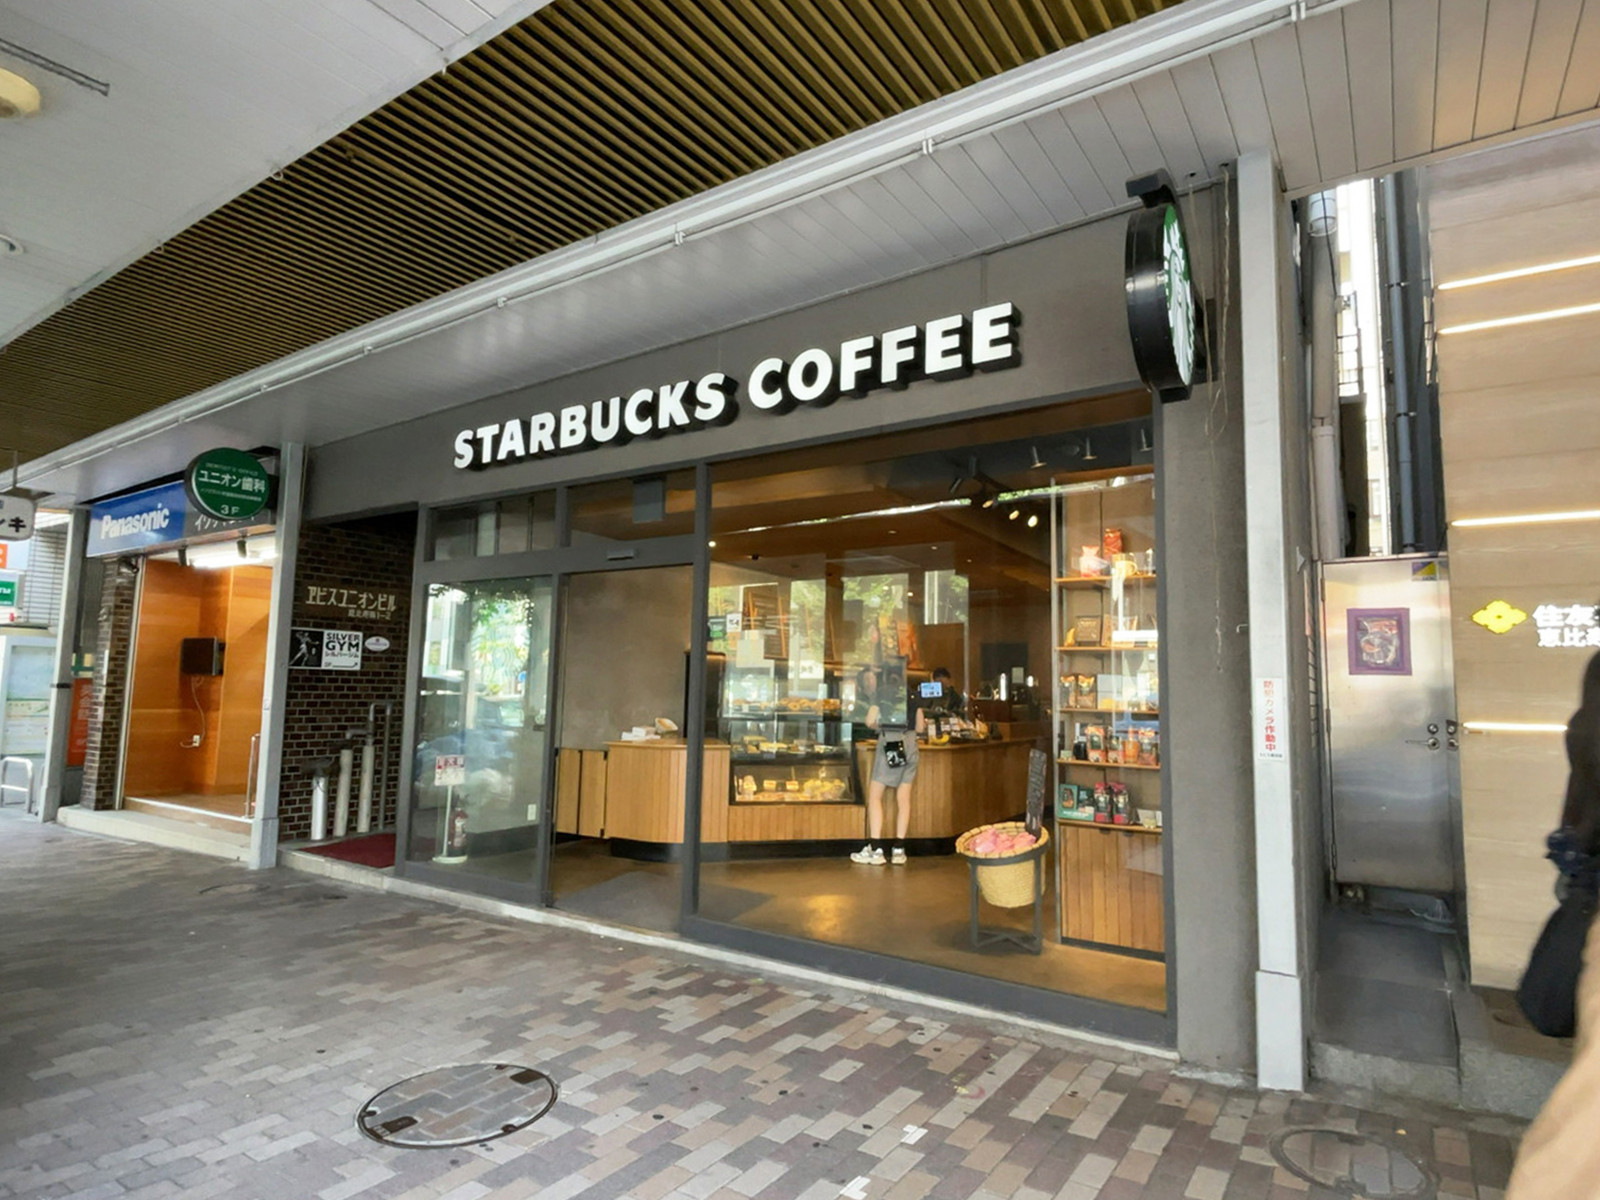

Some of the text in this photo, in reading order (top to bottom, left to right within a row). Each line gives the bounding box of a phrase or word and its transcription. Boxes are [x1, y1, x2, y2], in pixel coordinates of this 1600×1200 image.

[453, 302, 1013, 470] STARBUCKS COFFEE
[198, 470, 266, 494] ユニオン歯科
[101, 503, 170, 539] Panasonic
[1532, 604, 1600, 628] 住友
[325, 640, 360, 652] GYM
[326, 632, 360, 641] SILVER
